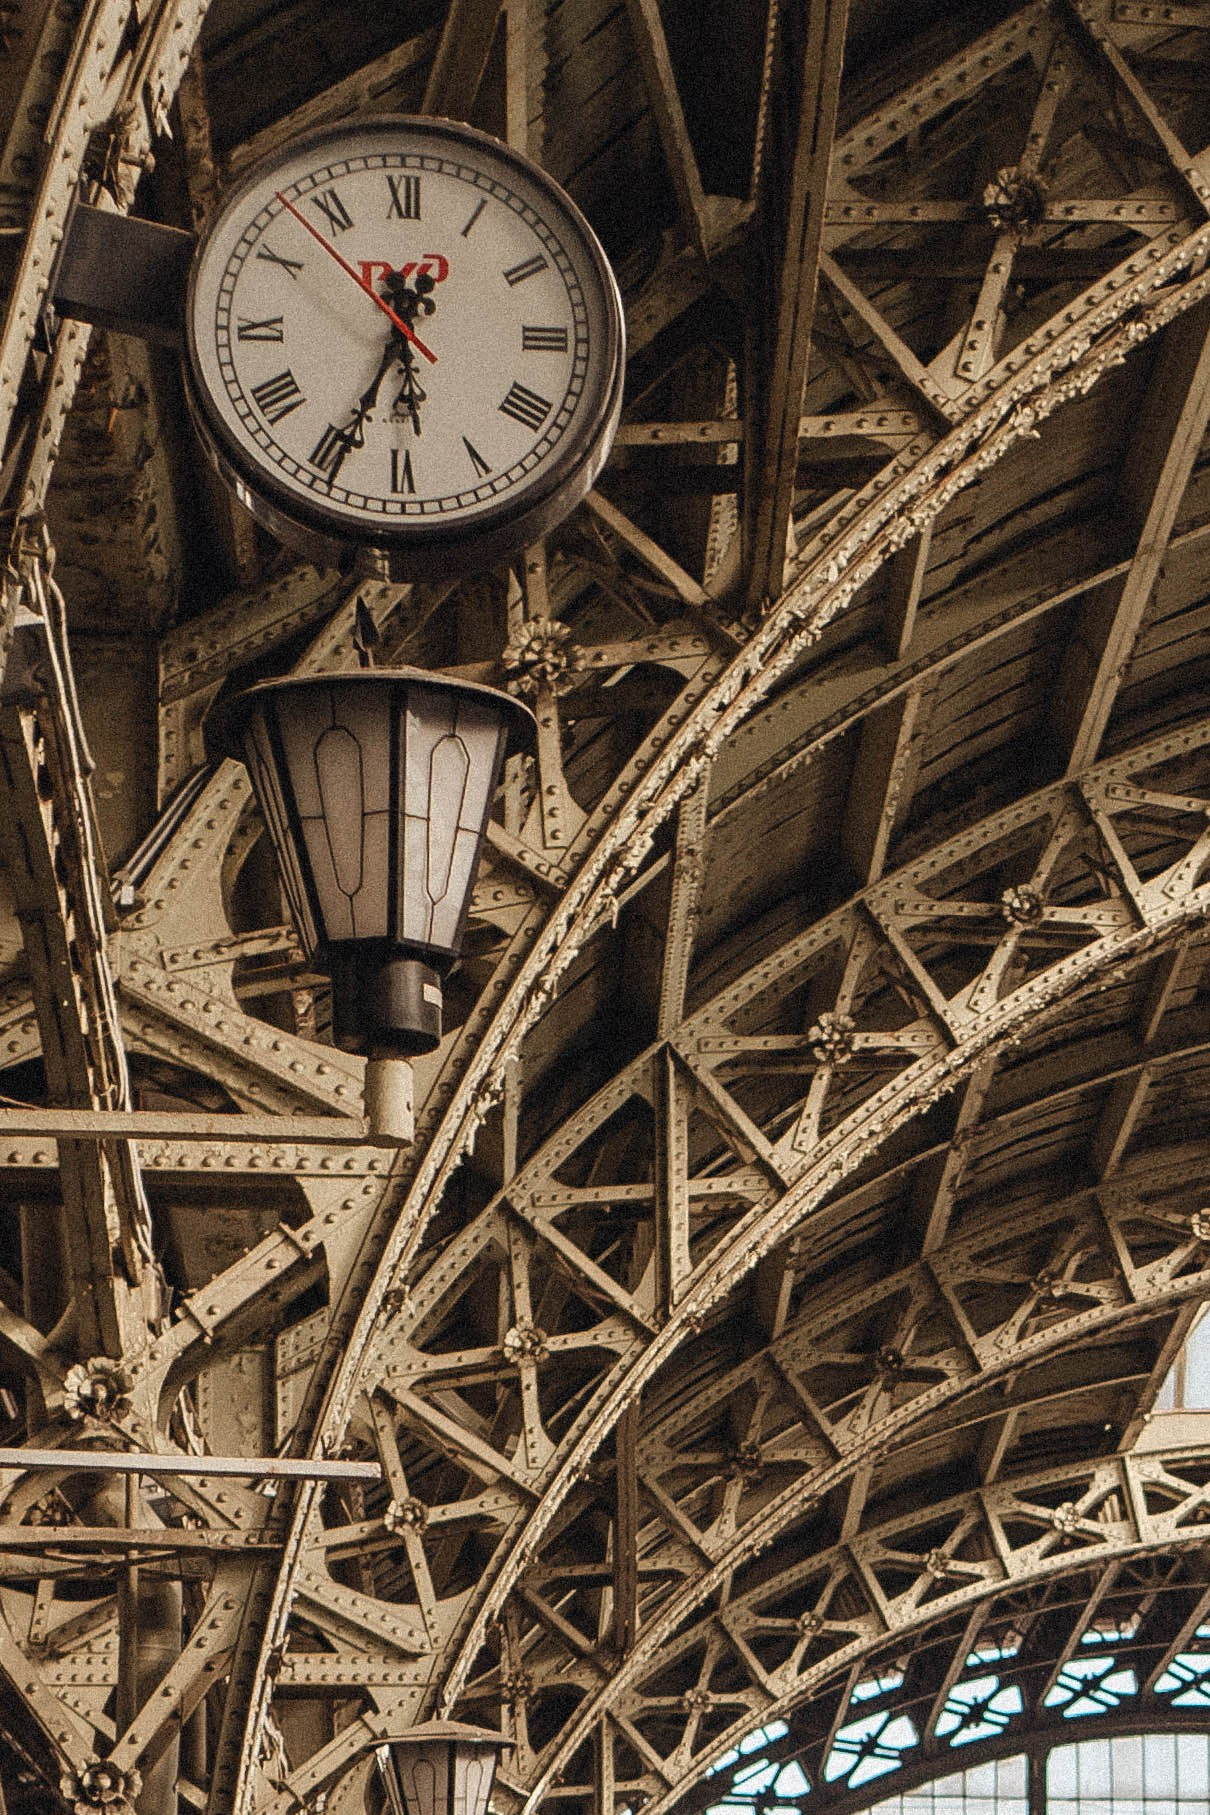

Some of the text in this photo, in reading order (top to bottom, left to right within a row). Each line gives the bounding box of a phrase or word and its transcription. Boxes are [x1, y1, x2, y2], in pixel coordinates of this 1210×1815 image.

[311, 189, 355, 237] XI
[386, 175, 422, 220] XII
[460, 199, 489, 238] I
[256, 243, 305, 280] X
[502, 253, 549, 287] II
[236, 316, 285, 345] IX
[521, 324, 569, 353] III
[390, 448, 417, 494] VI
[461, 435, 493, 480] V
